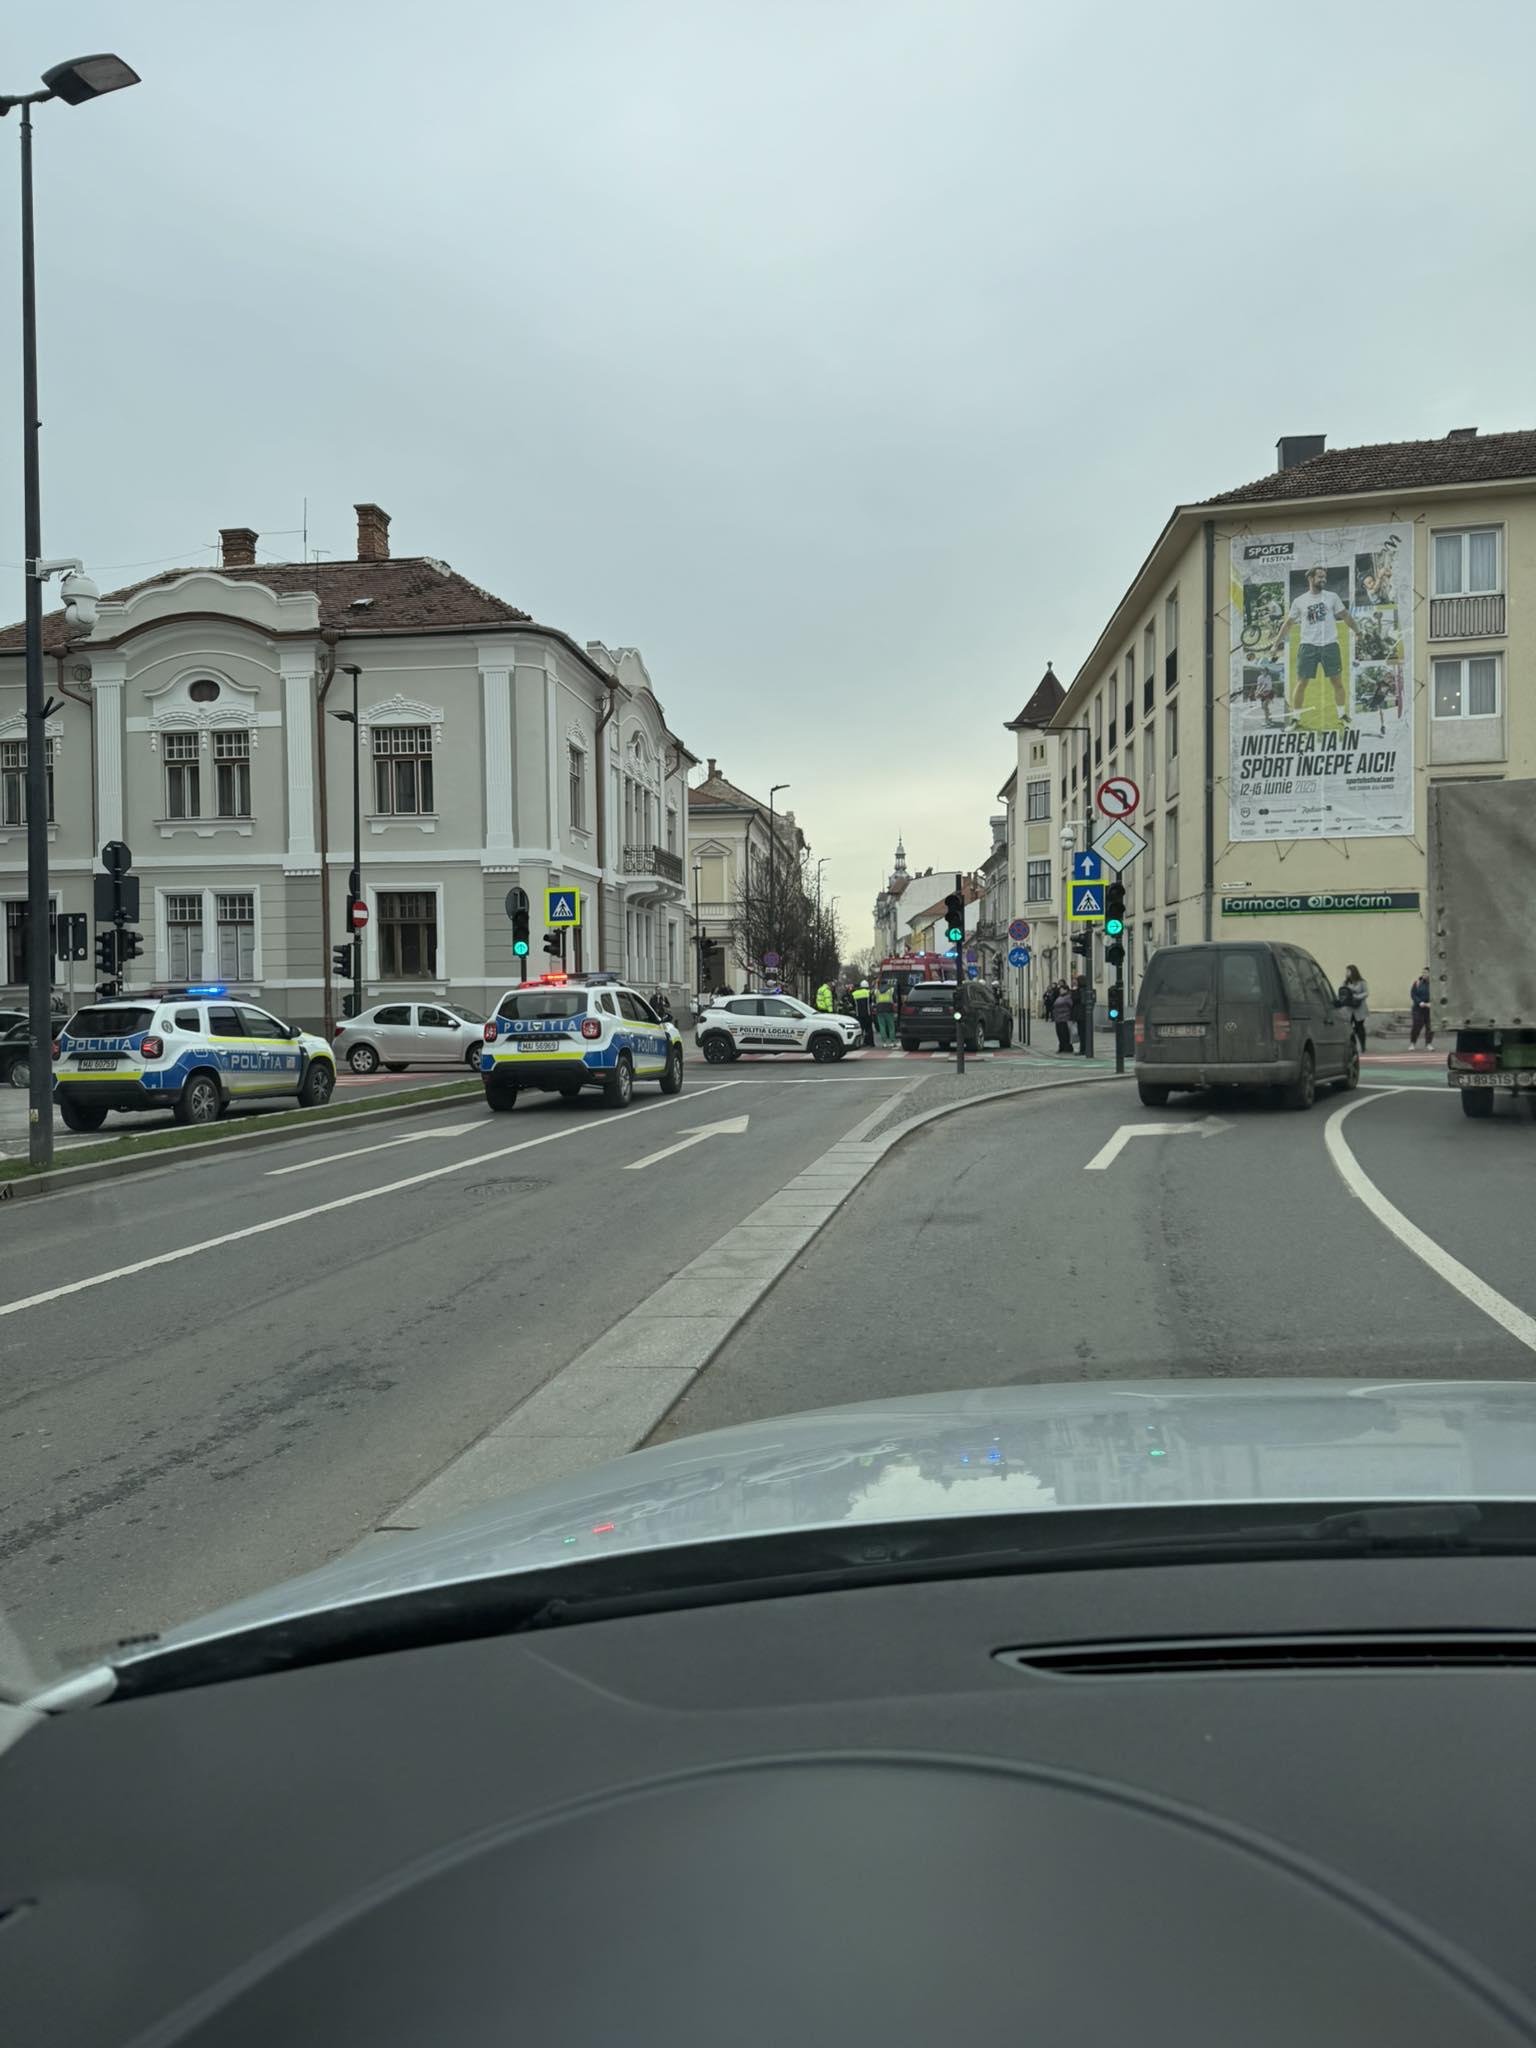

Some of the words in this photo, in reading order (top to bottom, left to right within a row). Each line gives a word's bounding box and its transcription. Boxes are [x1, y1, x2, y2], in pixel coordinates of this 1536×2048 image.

[1248, 545, 1289, 556] SPORTS
[1321, 731, 1338, 752] TA
[1342, 726, 1360, 750] ÎN
[1240, 757, 1294, 779] SPORT
[1296, 751, 1354, 776] ÎNCEPE
[1356, 751, 1396, 774] AICI!
[1263, 779, 1293, 795] iunie
[1224, 897, 1301, 911] Farmacia
